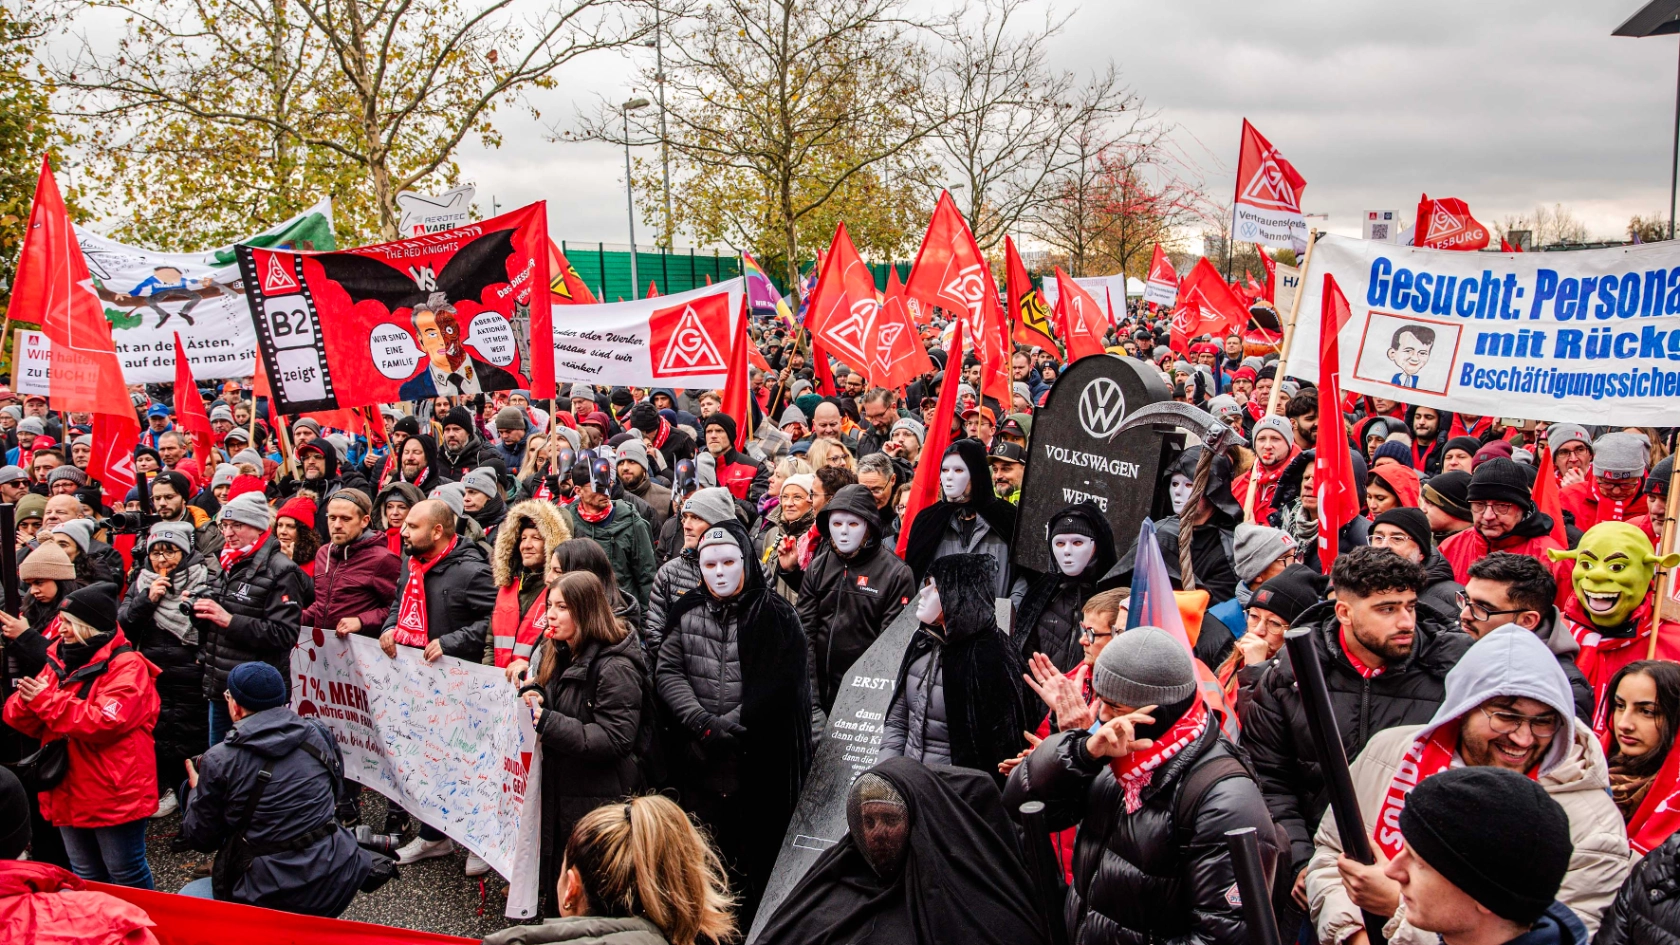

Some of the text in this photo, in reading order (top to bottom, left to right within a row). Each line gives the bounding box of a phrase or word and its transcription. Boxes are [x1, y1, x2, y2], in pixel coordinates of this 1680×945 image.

[425, 213, 465, 223] AEROTEC
[1239, 211, 1306, 229] Vertrauensleute
[1259, 228, 1293, 241] Hannov
[1425, 229, 1483, 249] LFSBURG
[385, 242, 459, 259] THE RED KNIGHTS
[1367, 257, 1680, 320] Gesucht: Persona
[271, 309, 309, 337] B2
[477, 325, 507, 335] AKTIONÄR
[133, 344, 151, 352] an
[187, 336, 234, 349] Ästen,
[372, 332, 408, 344] WIR SIND
[493, 335, 509, 343] MEHR
[580, 330, 602, 341] oder
[605, 332, 645, 346] Werker,
[1474, 328, 1546, 359] mit
[27, 348, 53, 361] WIR
[385, 346, 404, 355] EINE
[490, 345, 506, 353] WERT
[590, 349, 614, 359] sind
[615, 353, 632, 362] wir
[125, 356, 148, 368] auf
[204, 353, 236, 363] man
[382, 357, 414, 368] FAMILIE
[27, 368, 41, 377] zu
[46, 368, 84, 381] EUCH
[283, 366, 316, 383] zeigt
[1045, 444, 1140, 480] VOLKSWAGEN
[298, 674, 307, 697] 7
[310, 677, 326, 702] %
[851, 675, 889, 690] ERST
[319, 704, 344, 719] NÖTIG
[344, 709, 359, 723] UND
[855, 708, 882, 720] dann
[834, 719, 858, 730] dann
[859, 722, 875, 732] die
[350, 731, 364, 748] bin
[831, 731, 853, 741] dann
[854, 733, 869, 743] die
[846, 744, 879, 755] dann die
[842, 753, 873, 764] dann die
